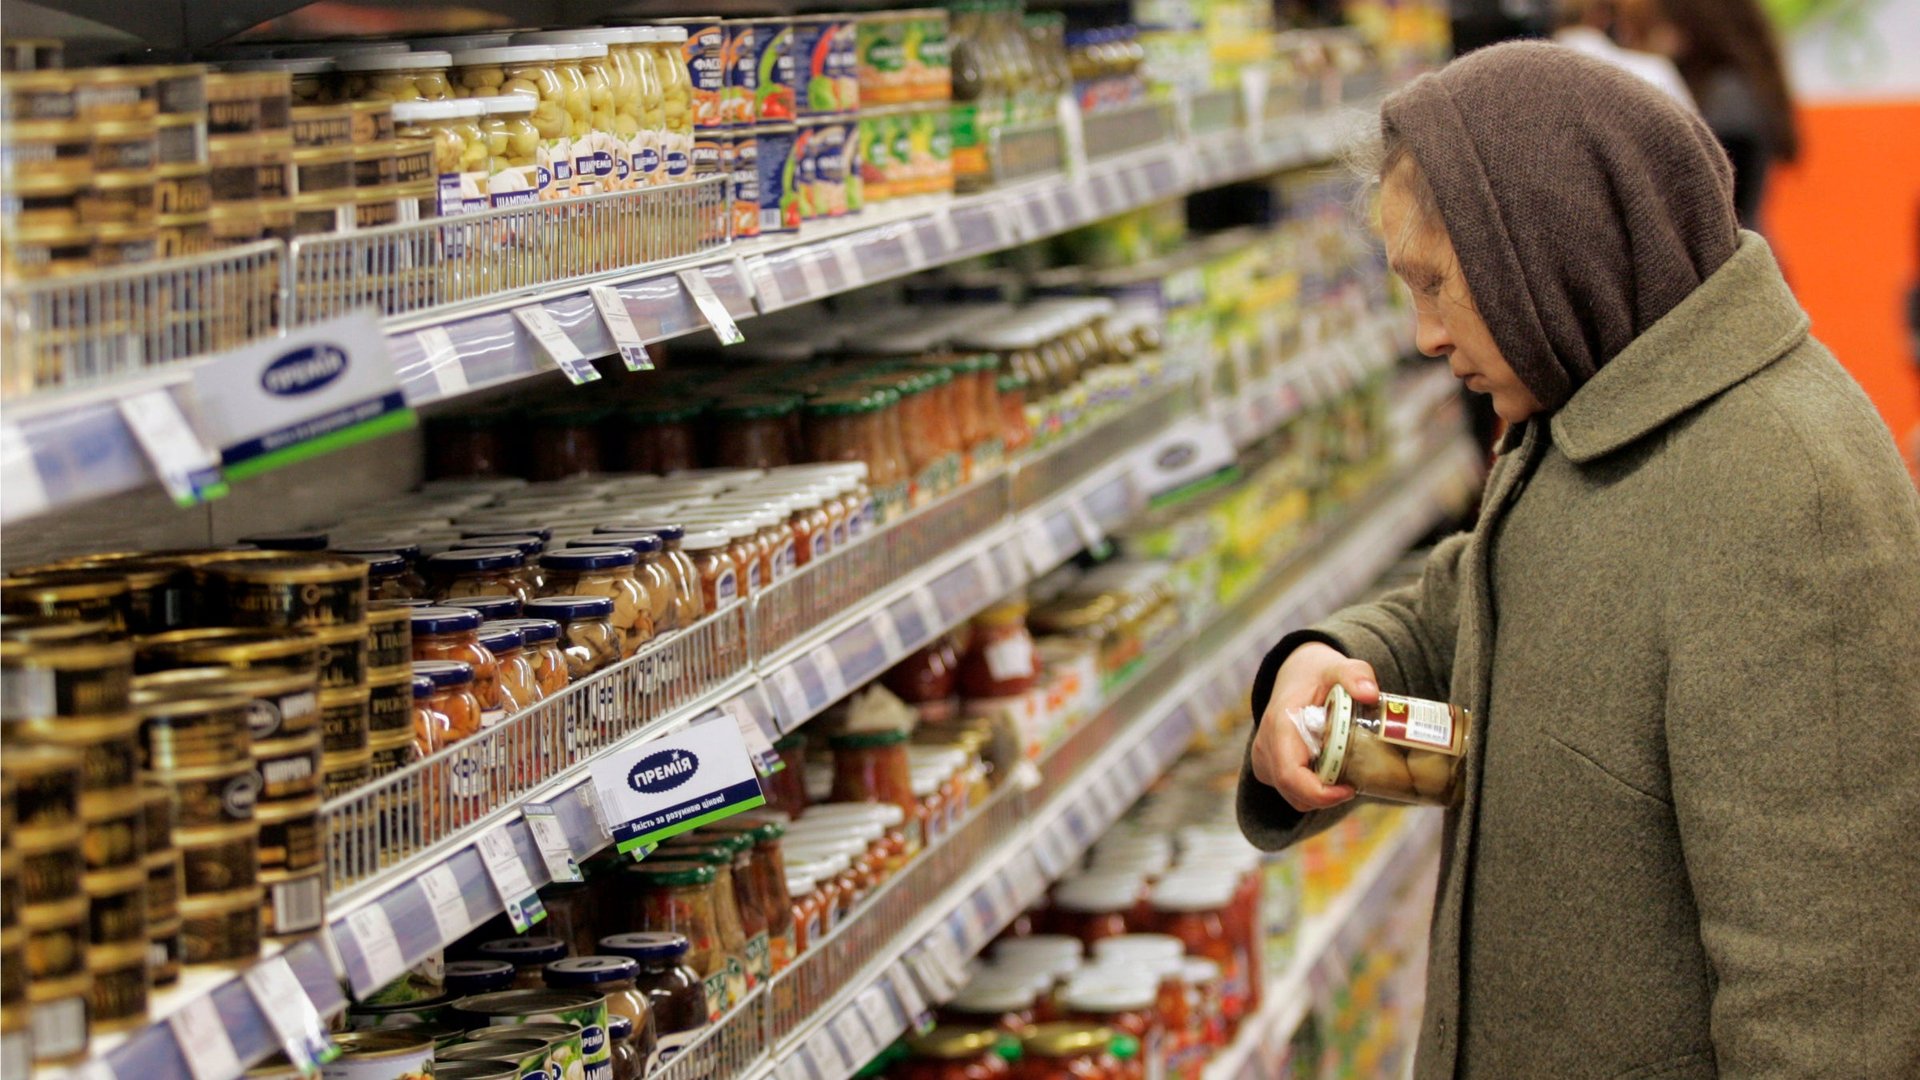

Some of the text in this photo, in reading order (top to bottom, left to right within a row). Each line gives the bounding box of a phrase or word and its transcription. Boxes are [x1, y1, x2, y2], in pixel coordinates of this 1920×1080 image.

[633, 756, 693, 788] ПРЕМІЯ
[631, 793, 725, 833] Якість за розумною ціною!
[584, 1034, 603, 1048] РЕМІЯ
